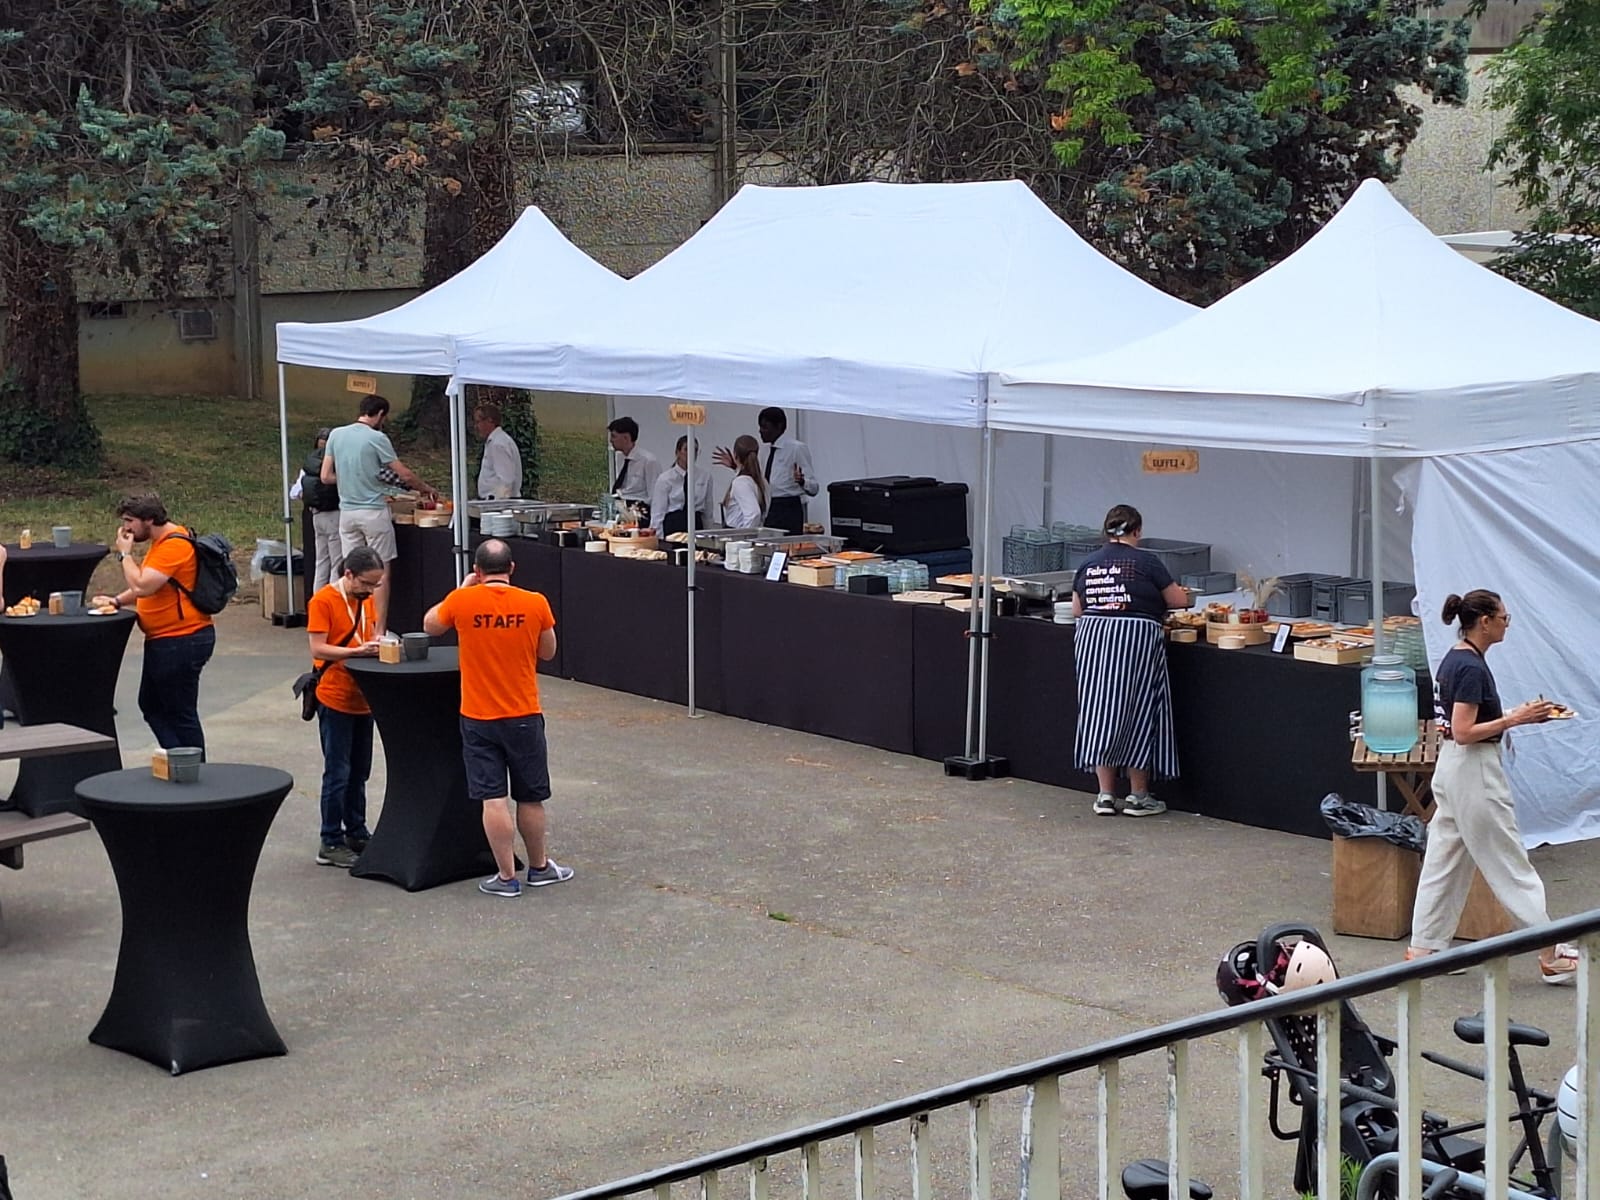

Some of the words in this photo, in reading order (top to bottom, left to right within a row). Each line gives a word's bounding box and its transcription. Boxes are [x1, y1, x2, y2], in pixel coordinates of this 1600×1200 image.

[1086, 565, 1107, 576] Faire
[1109, 564, 1121, 575] du
[1085, 575, 1115, 586] monde
[1085, 583, 1126, 595] connecté
[1098, 593, 1131, 603] endroit
[473, 614, 526, 629] STAFF
